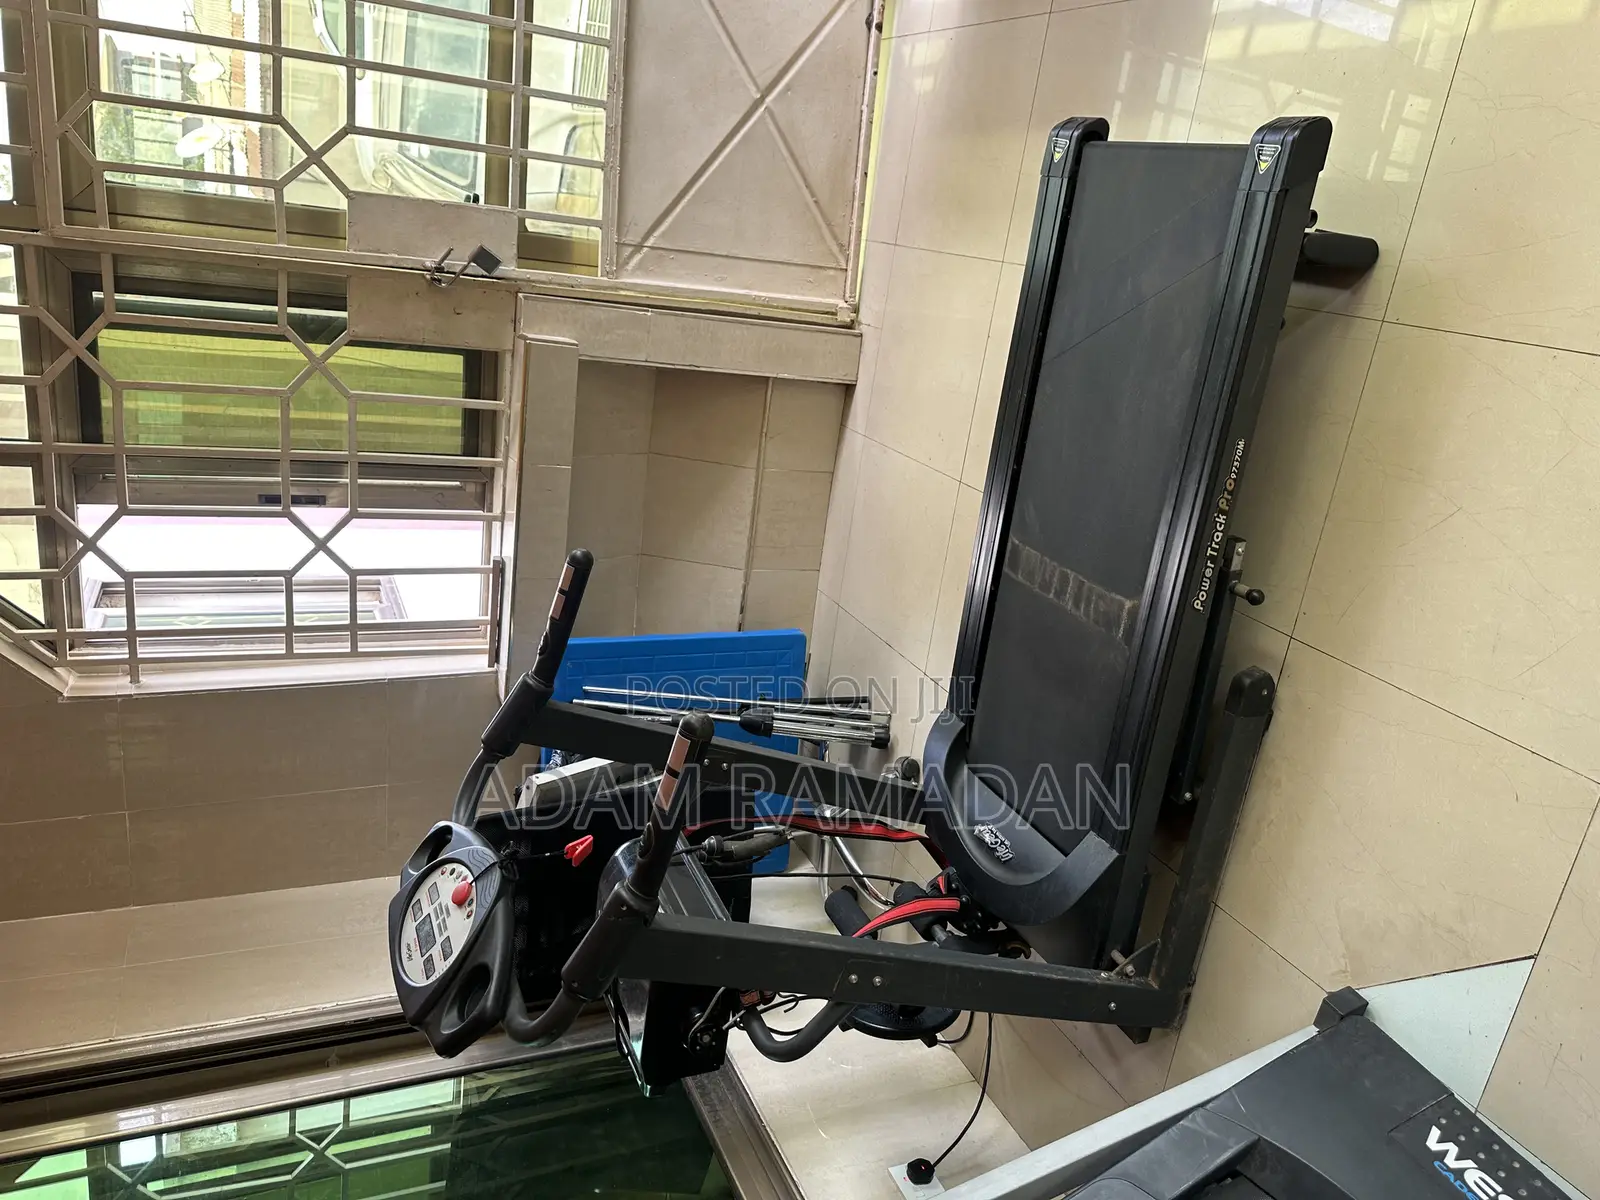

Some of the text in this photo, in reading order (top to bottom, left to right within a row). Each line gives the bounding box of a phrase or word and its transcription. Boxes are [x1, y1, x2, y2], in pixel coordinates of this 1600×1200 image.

[1194, 560, 1215, 611] Power
[1206, 513, 1227, 556] Track
[1218, 478, 1235, 511] Pro
[1425, 1125, 1515, 1200] WE
